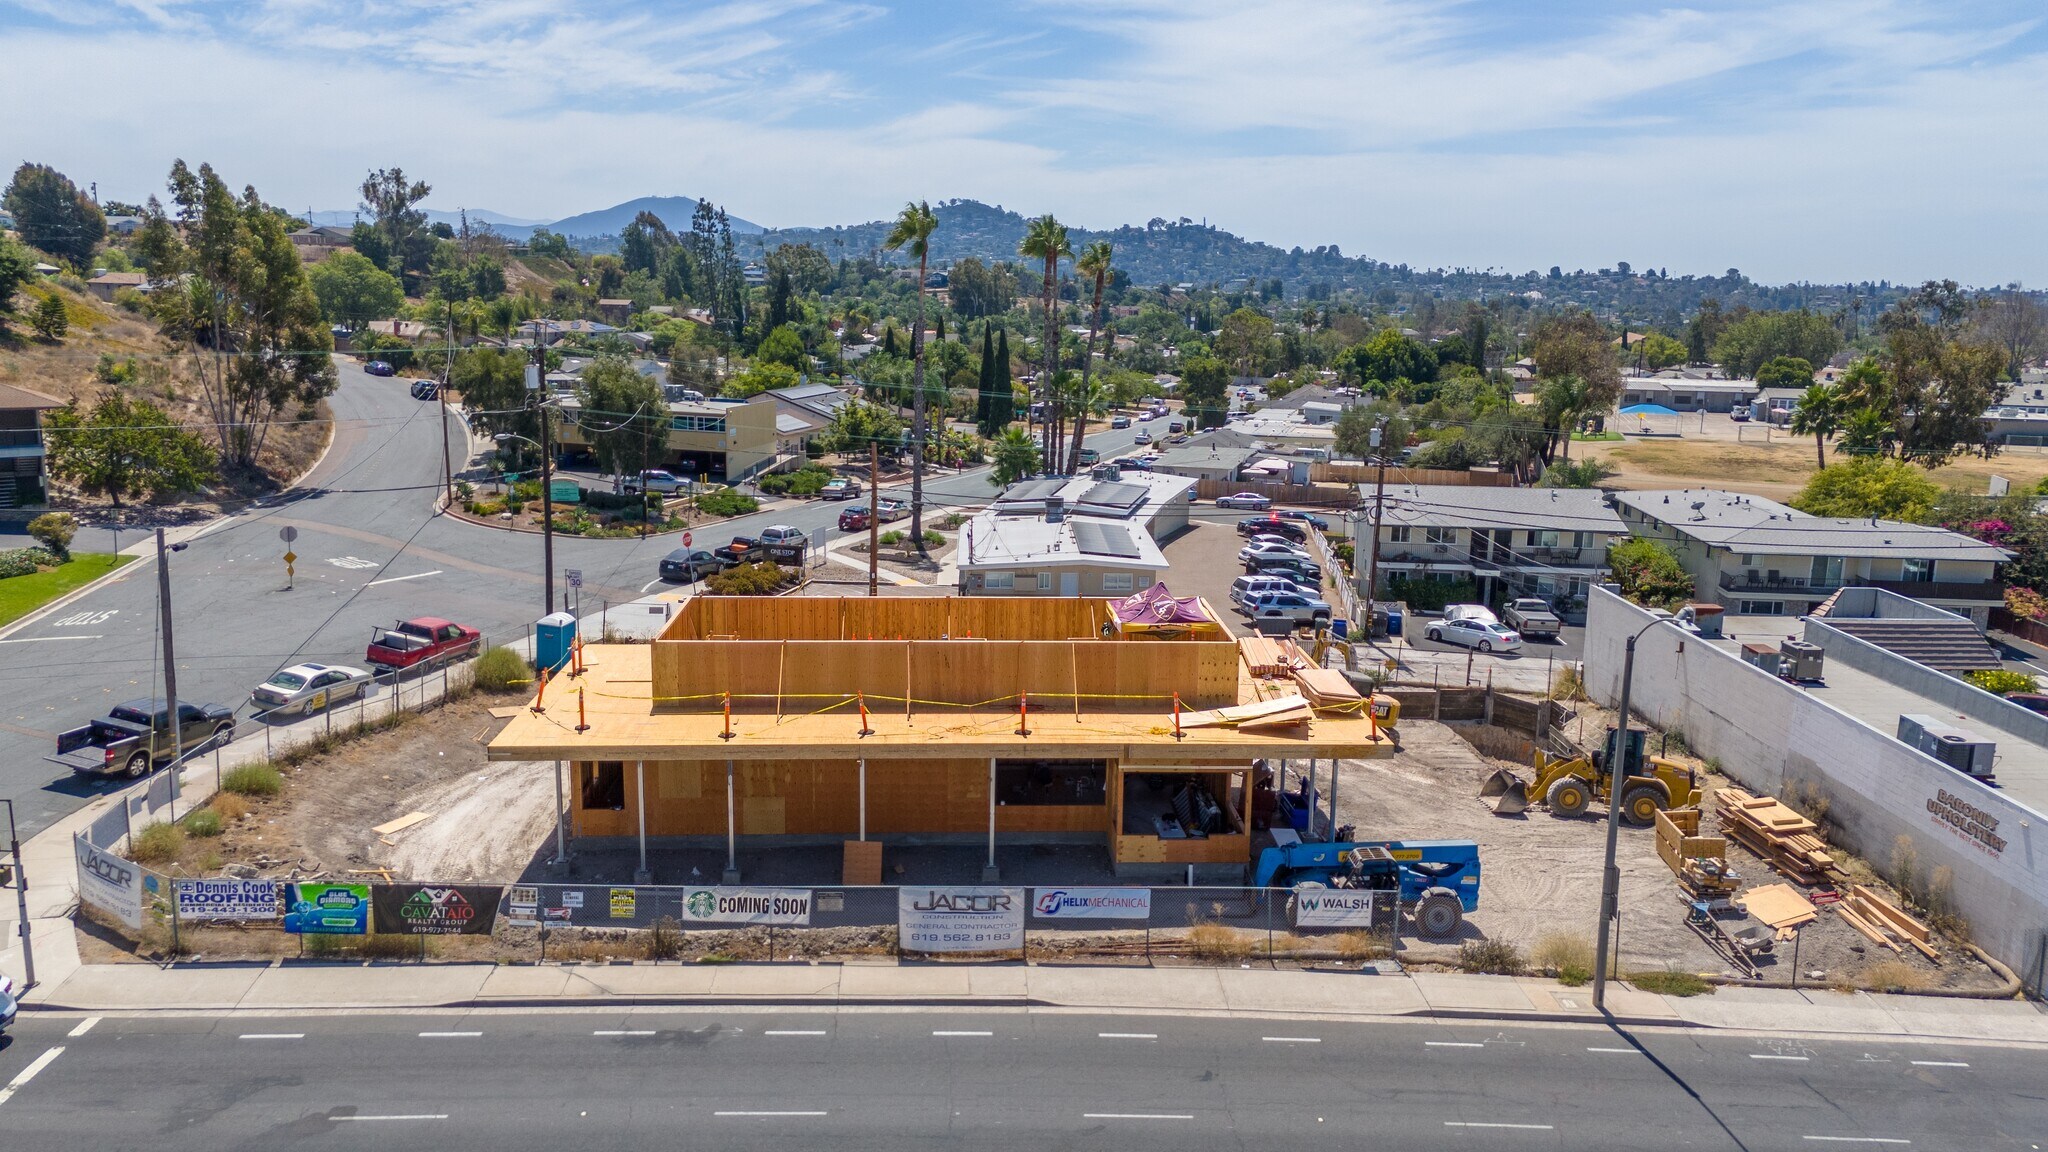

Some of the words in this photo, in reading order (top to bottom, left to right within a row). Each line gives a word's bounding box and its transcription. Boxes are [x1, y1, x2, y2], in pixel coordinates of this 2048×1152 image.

[571, 578, 581, 586] 30
[1374, 705, 1389, 716] CAT
[1643, 762, 1655, 770] CAT
[1926, 798, 2008, 853] UPHOLSTERY
[80, 849, 132, 889] JACOR
[196, 881, 239, 894] Dennis
[243, 881, 275, 894] Cook
[180, 894, 275, 903] ROOFING
[913, 891, 1012, 911] JACOR
[1323, 898, 1370, 909] WALSH
[719, 897, 770, 915] COMING
[773, 898, 808, 916] SOON
[400, 906, 475, 919] CAVATAIO
[954, 922, 1018, 930] CONTRACTOR
[911, 933, 1011, 942] 619.562.8183
